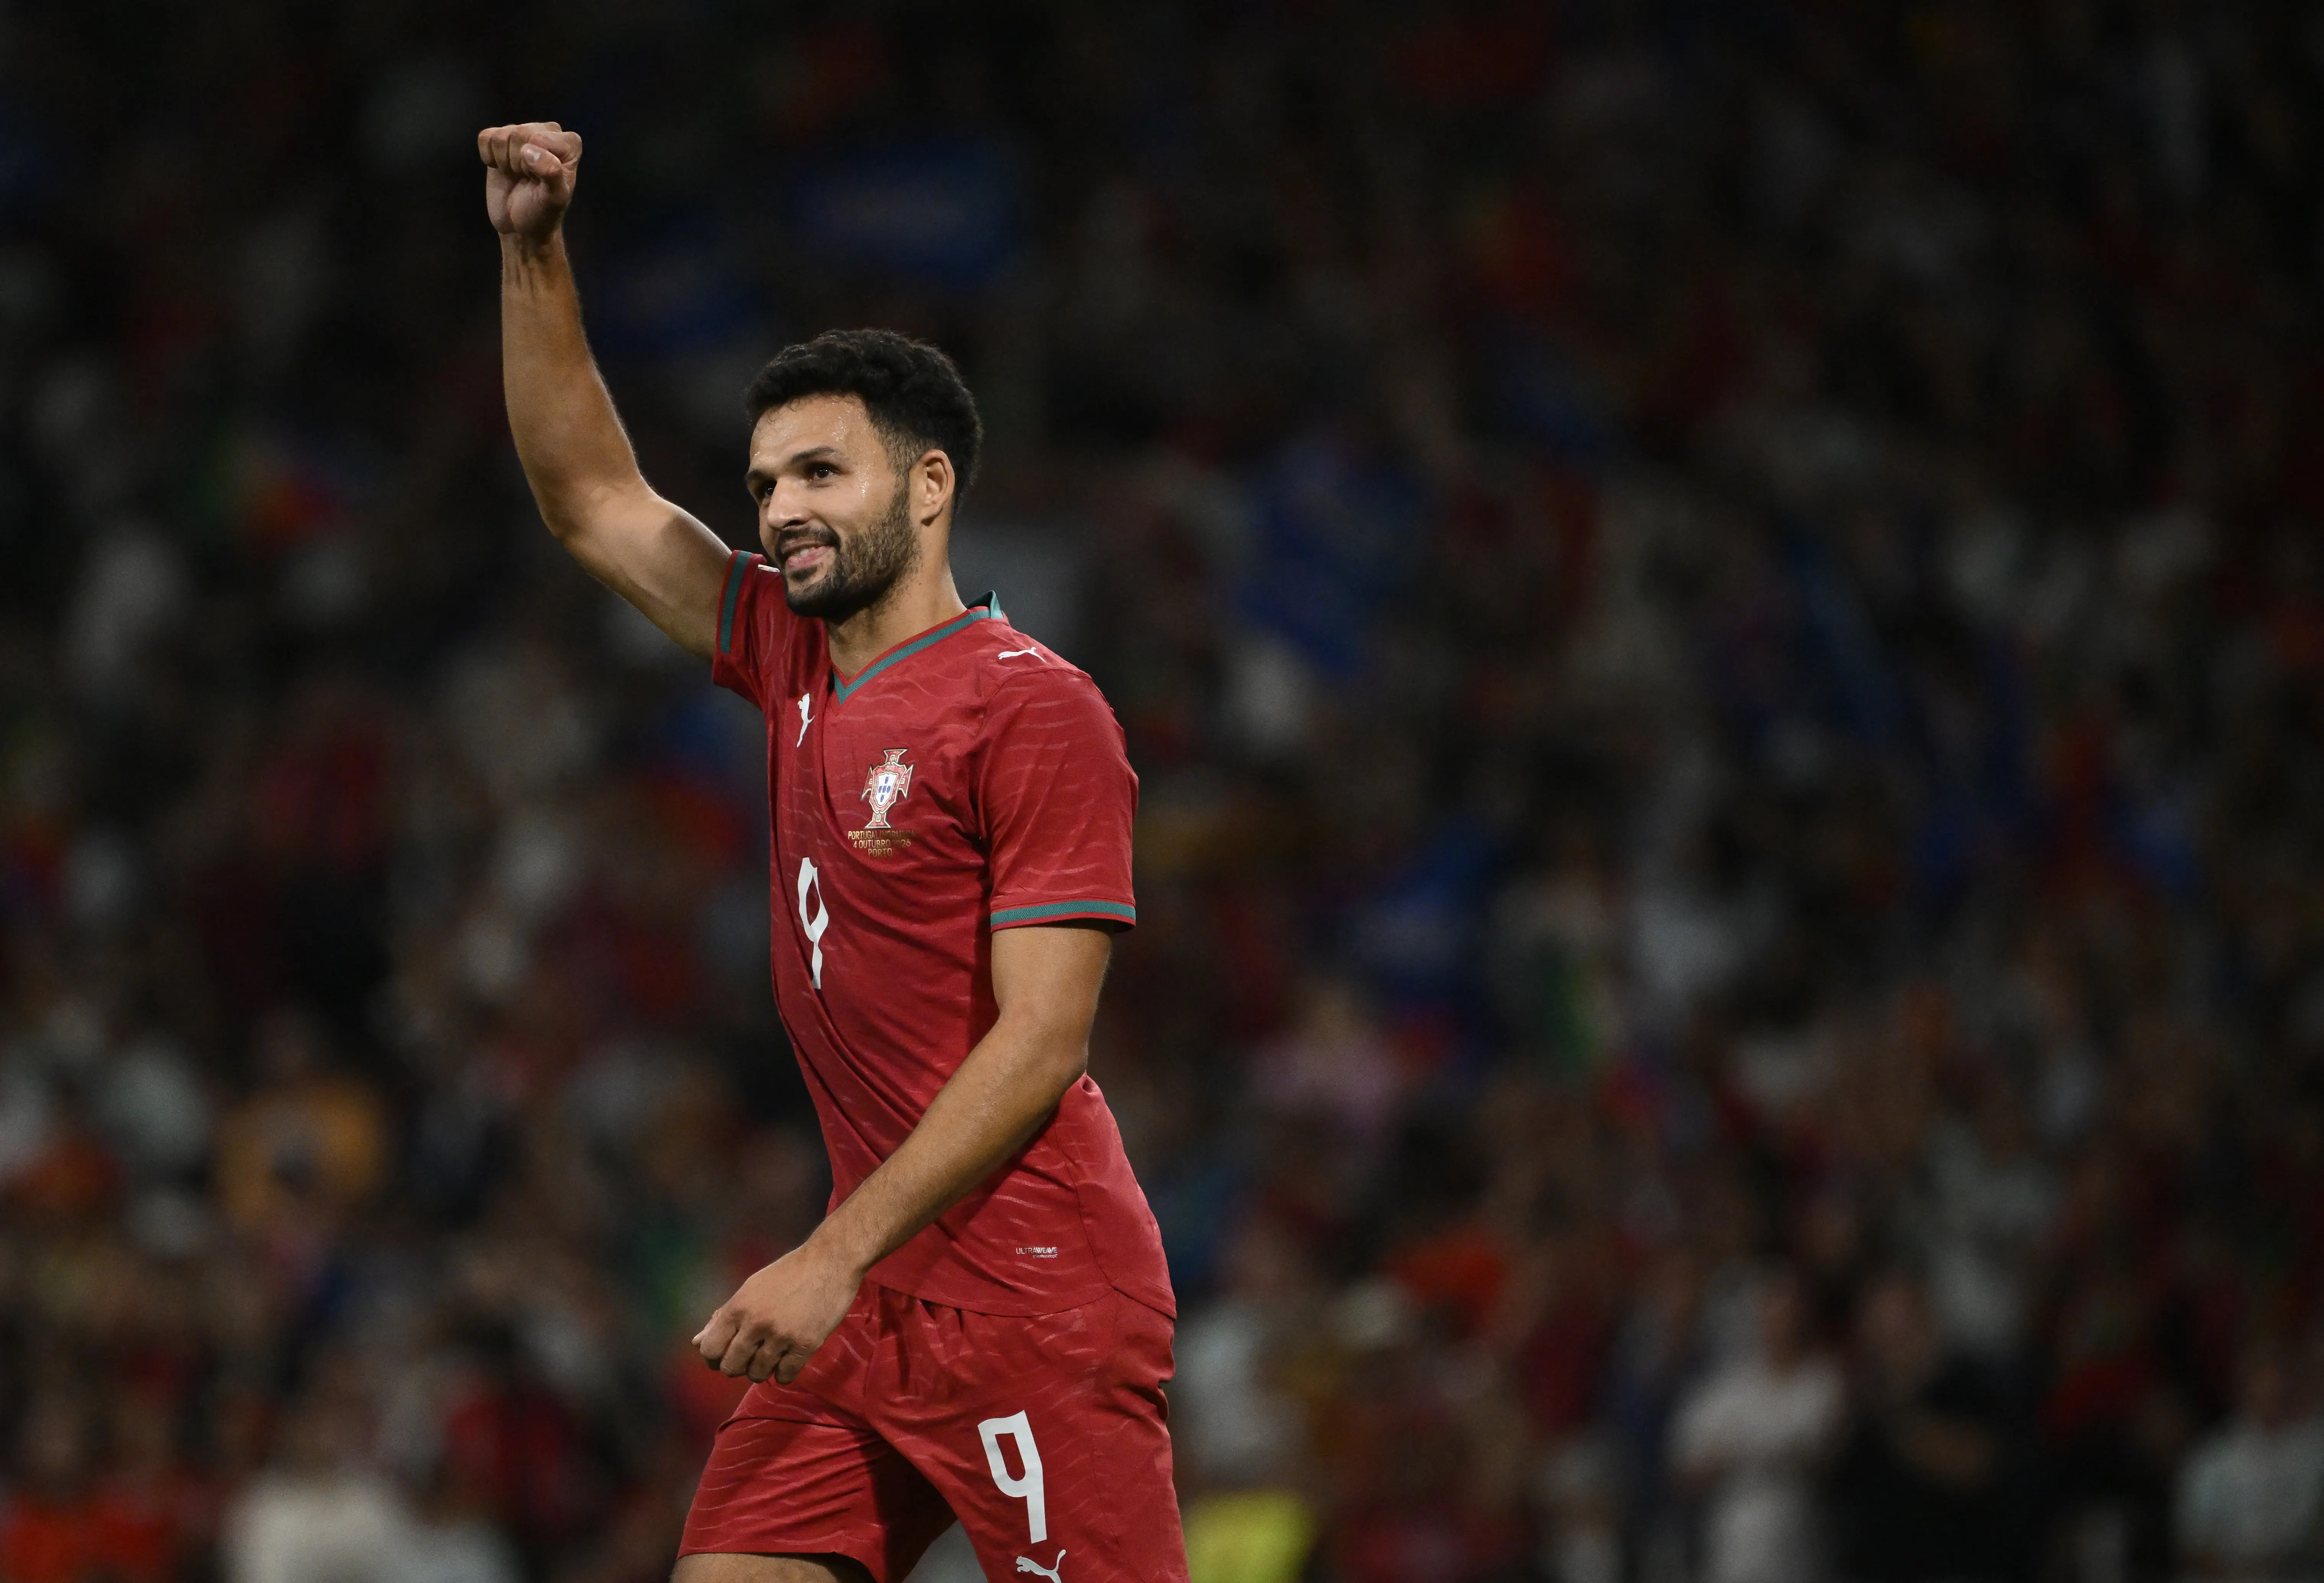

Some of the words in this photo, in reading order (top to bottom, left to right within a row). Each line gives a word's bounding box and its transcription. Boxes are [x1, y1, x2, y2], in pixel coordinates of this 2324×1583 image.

[858, 840, 891, 848] OUTUBRO
[892, 839, 911, 848] 26
[868, 848, 893, 858] PORTO
[797, 857, 829, 989] 9
[977, 1410, 1047, 1544] 9
